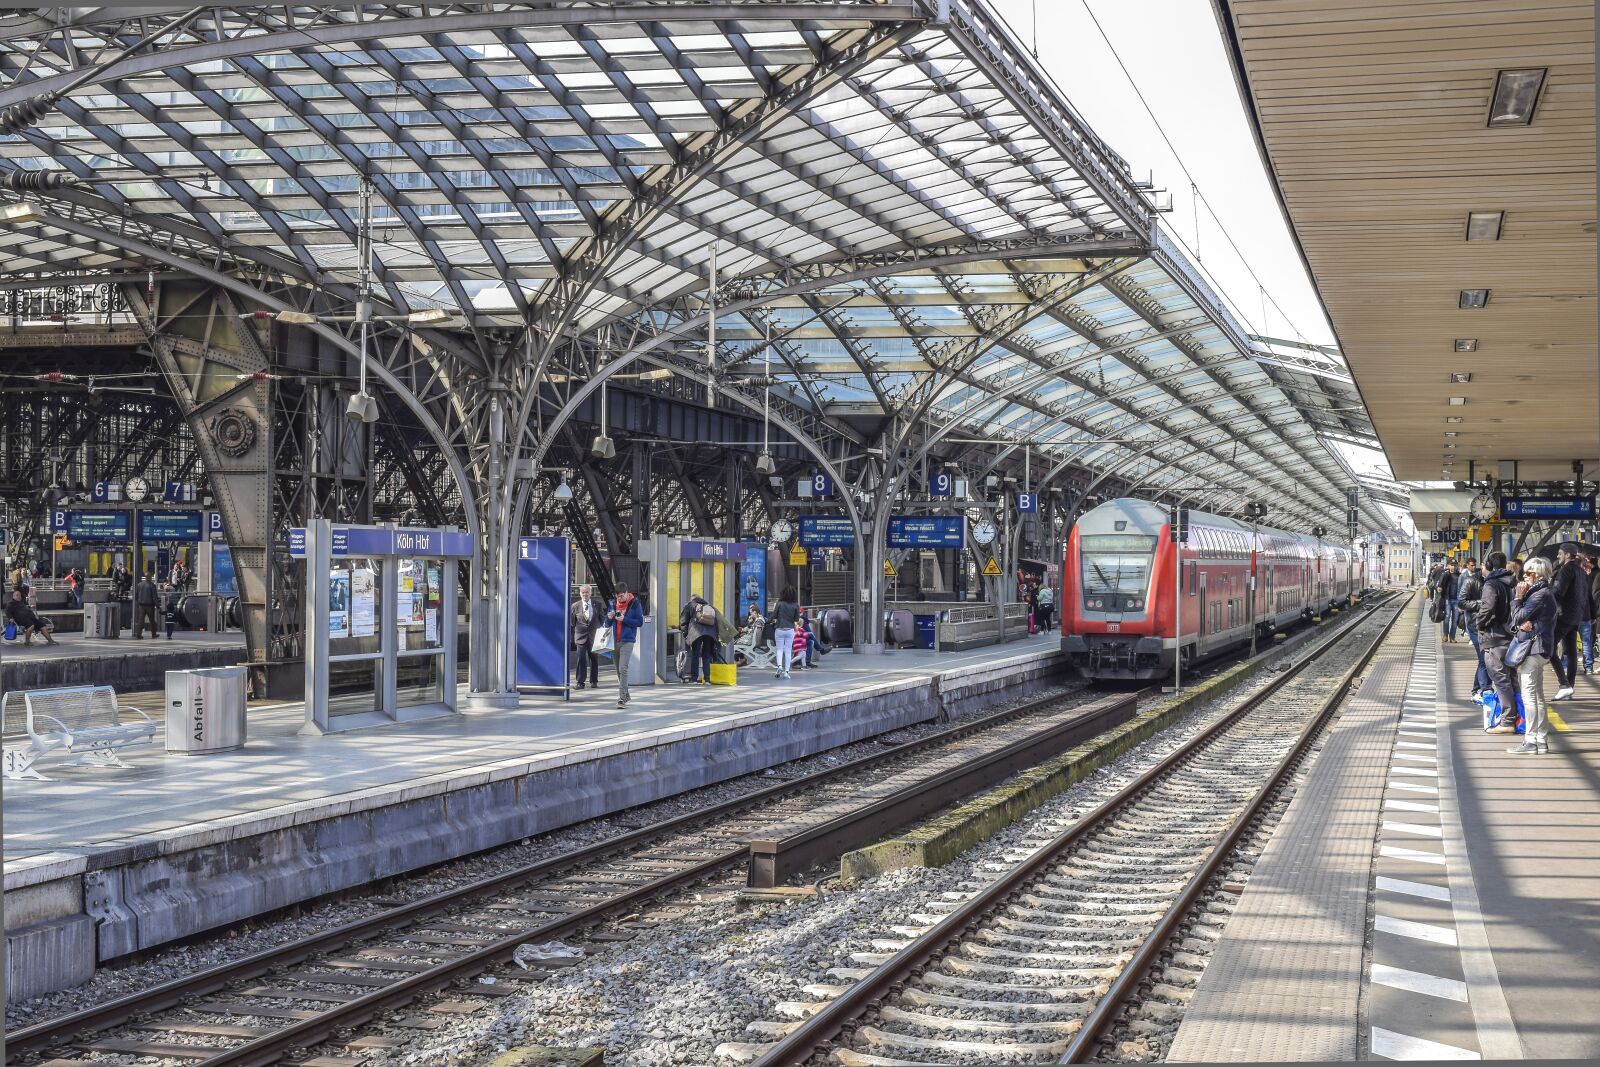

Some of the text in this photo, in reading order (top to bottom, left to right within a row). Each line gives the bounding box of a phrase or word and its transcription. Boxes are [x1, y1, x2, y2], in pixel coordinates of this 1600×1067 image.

[95, 482, 104, 497] 6
[172, 482, 181, 497] 7
[814, 474, 825, 491] 8
[937, 474, 948, 491] 9
[1019, 494, 1030, 509] B
[1506, 502, 1517, 511] 10
[55, 512, 65, 526] B
[211, 513, 221, 529] B
[689, 518, 696, 528] 6
[397, 533, 430, 549] Köln Hbf
[1431, 531, 1439, 541] B
[1445, 530, 1457, 541] 10
[194, 698, 204, 742] Abfall
